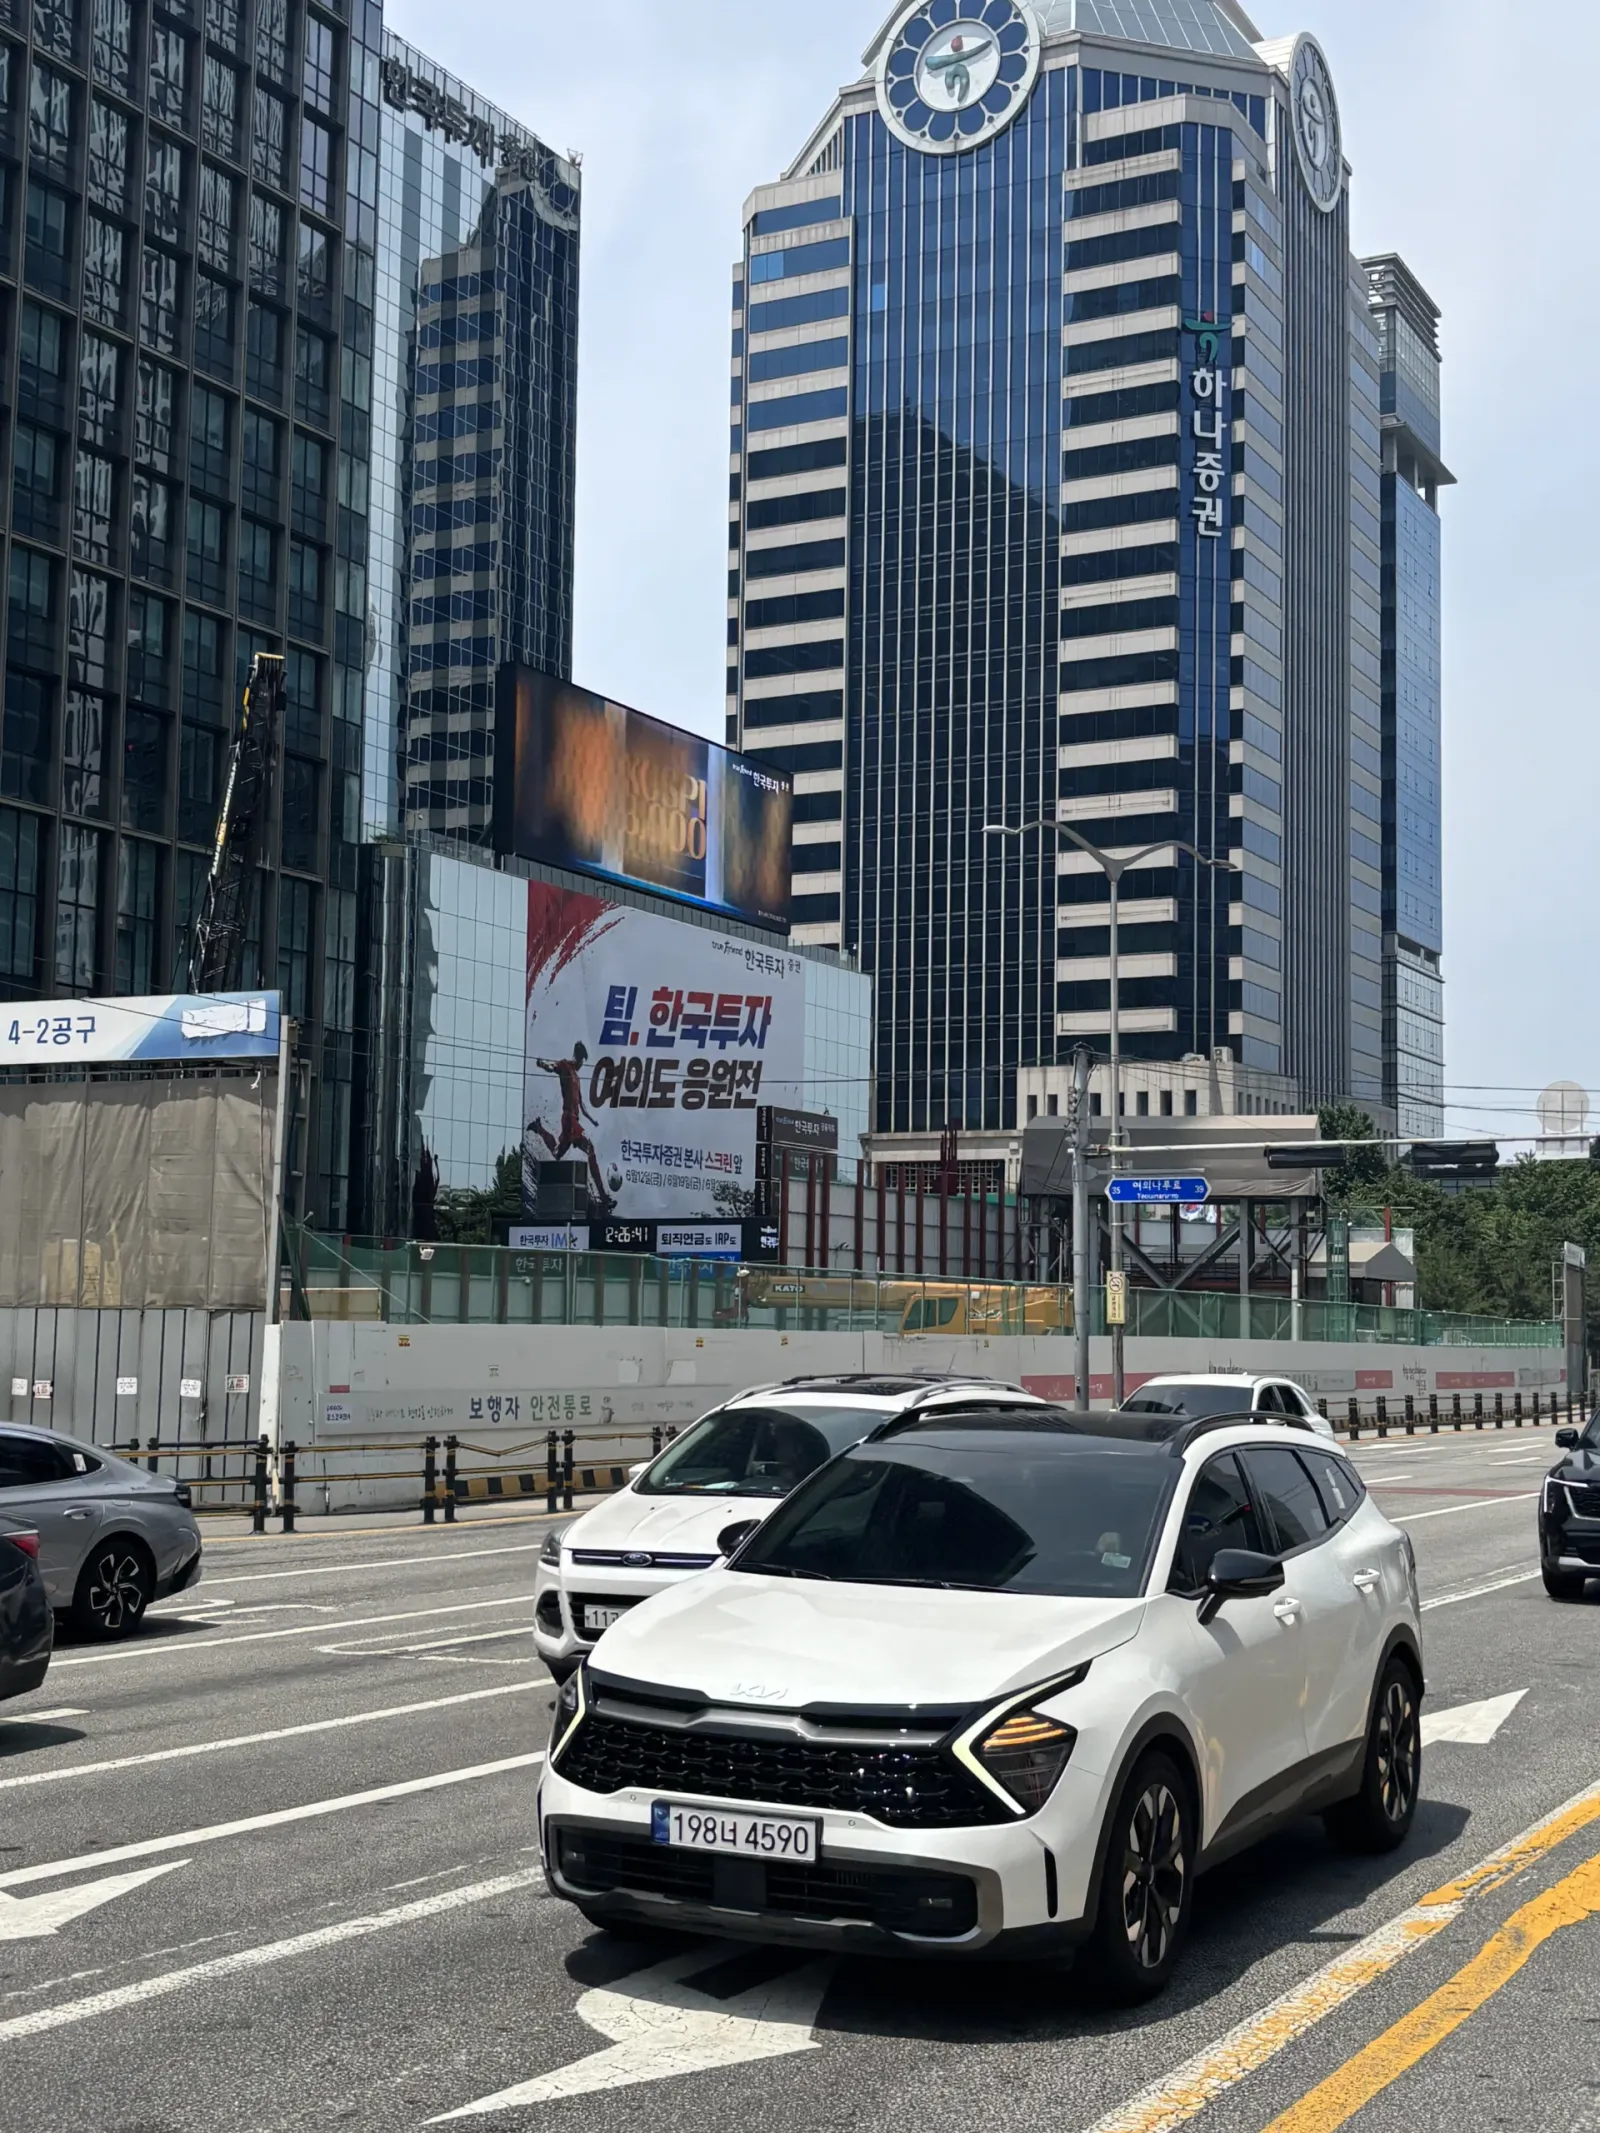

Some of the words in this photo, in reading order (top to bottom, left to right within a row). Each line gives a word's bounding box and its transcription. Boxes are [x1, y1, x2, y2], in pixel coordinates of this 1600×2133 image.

[383, 56, 494, 168] 한국투자
[1191, 366, 1227, 537] 하나증권
[753, 771, 779, 795] 한국투자
[745, 948, 785, 979] 한국투자
[788, 958, 801, 974] 증권
[8, 1016, 97, 1045] 4-2공구
[598, 984, 640, 1046] 팀.
[646, 986, 773, 1049] 한국투자
[589, 1056, 680, 1109] 여의도
[681, 1058, 764, 1110] 응원전
[620, 1139, 682, 1167] 한국투자증권
[683, 1148, 703, 1170] 본사
[704, 1151, 733, 1174] 스크린
[733, 1154, 743, 1175] 앞
[1111, 1186, 1121, 1196] 35
[1132, 1180, 1182, 1191] 여의나루로
[519, 1234, 549, 1247] 한국투자
[661, 1232, 712, 1246] 퇴직연금도
[714, 1232, 737, 1246] IRP도
[775, 1284, 804, 1293] KATO
[469, 1395, 520, 1423] 보행자
[530, 1394, 592, 1422] 안전통로
[674, 1812, 738, 1847] 198너
[744, 1821, 809, 1855] 4590
